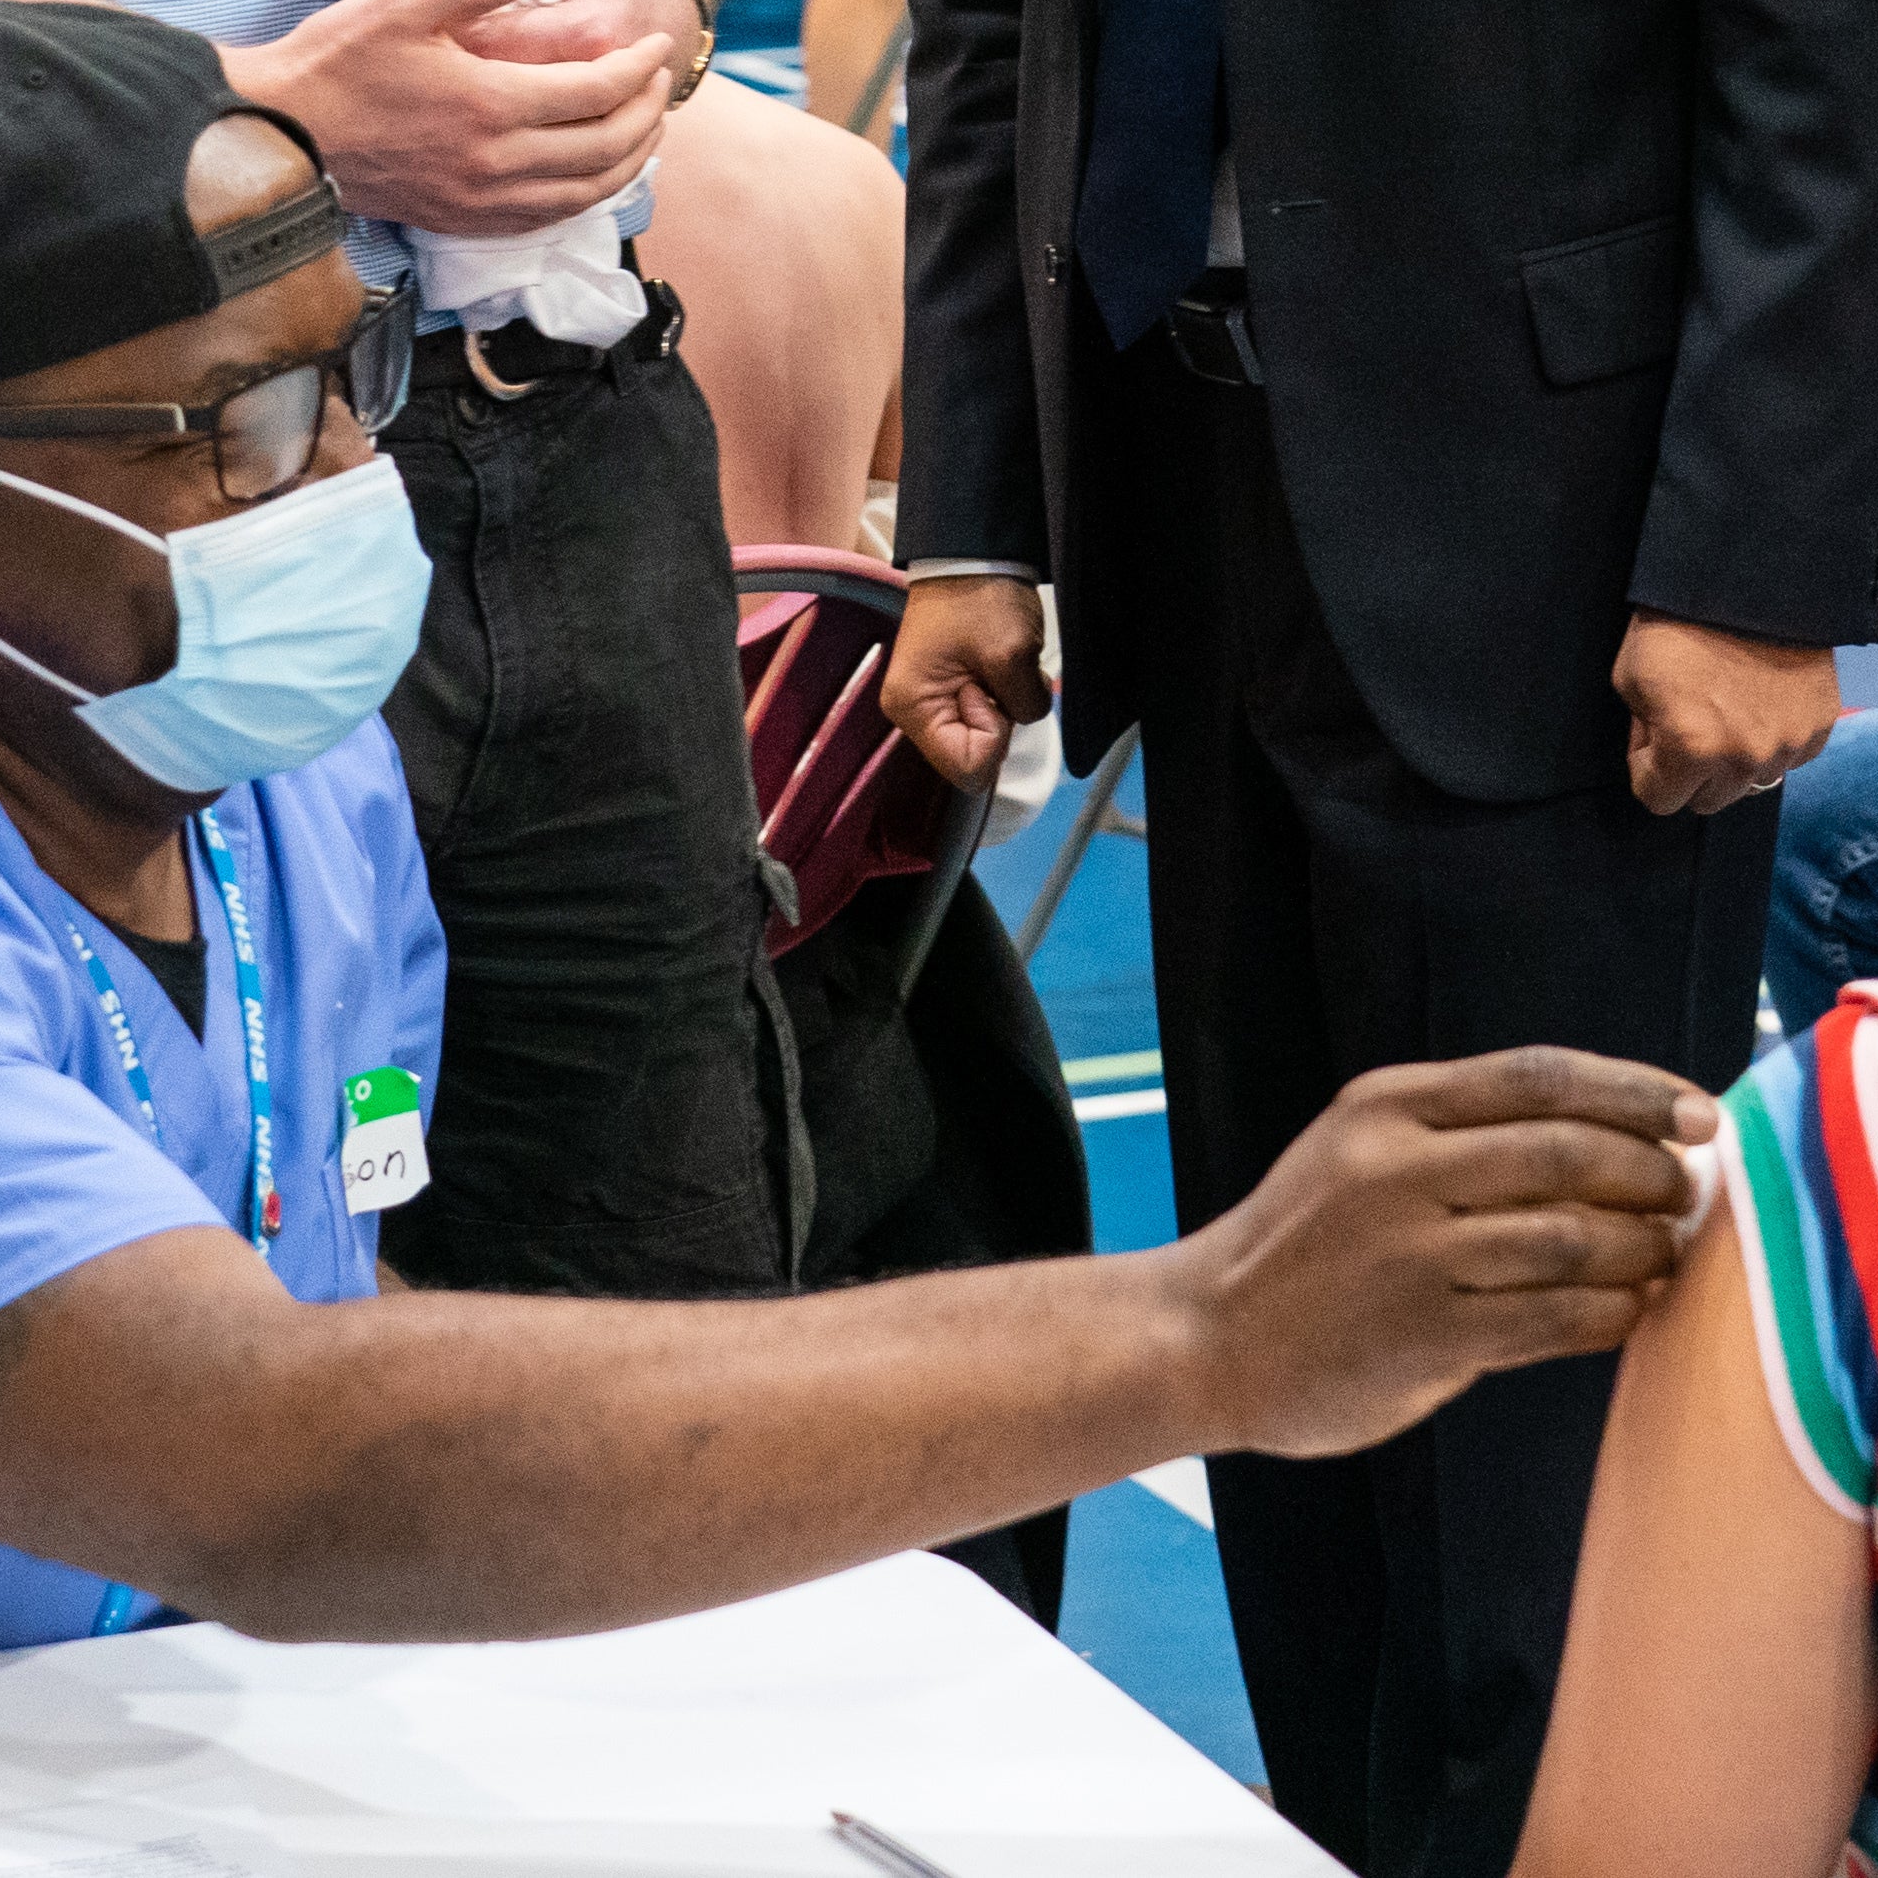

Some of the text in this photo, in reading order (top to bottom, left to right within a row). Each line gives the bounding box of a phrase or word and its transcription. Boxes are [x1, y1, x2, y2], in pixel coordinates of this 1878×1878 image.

[223, 880, 256, 965] NHS
[99, 989, 139, 1071] NHS
[244, 996, 268, 1083] NHS
